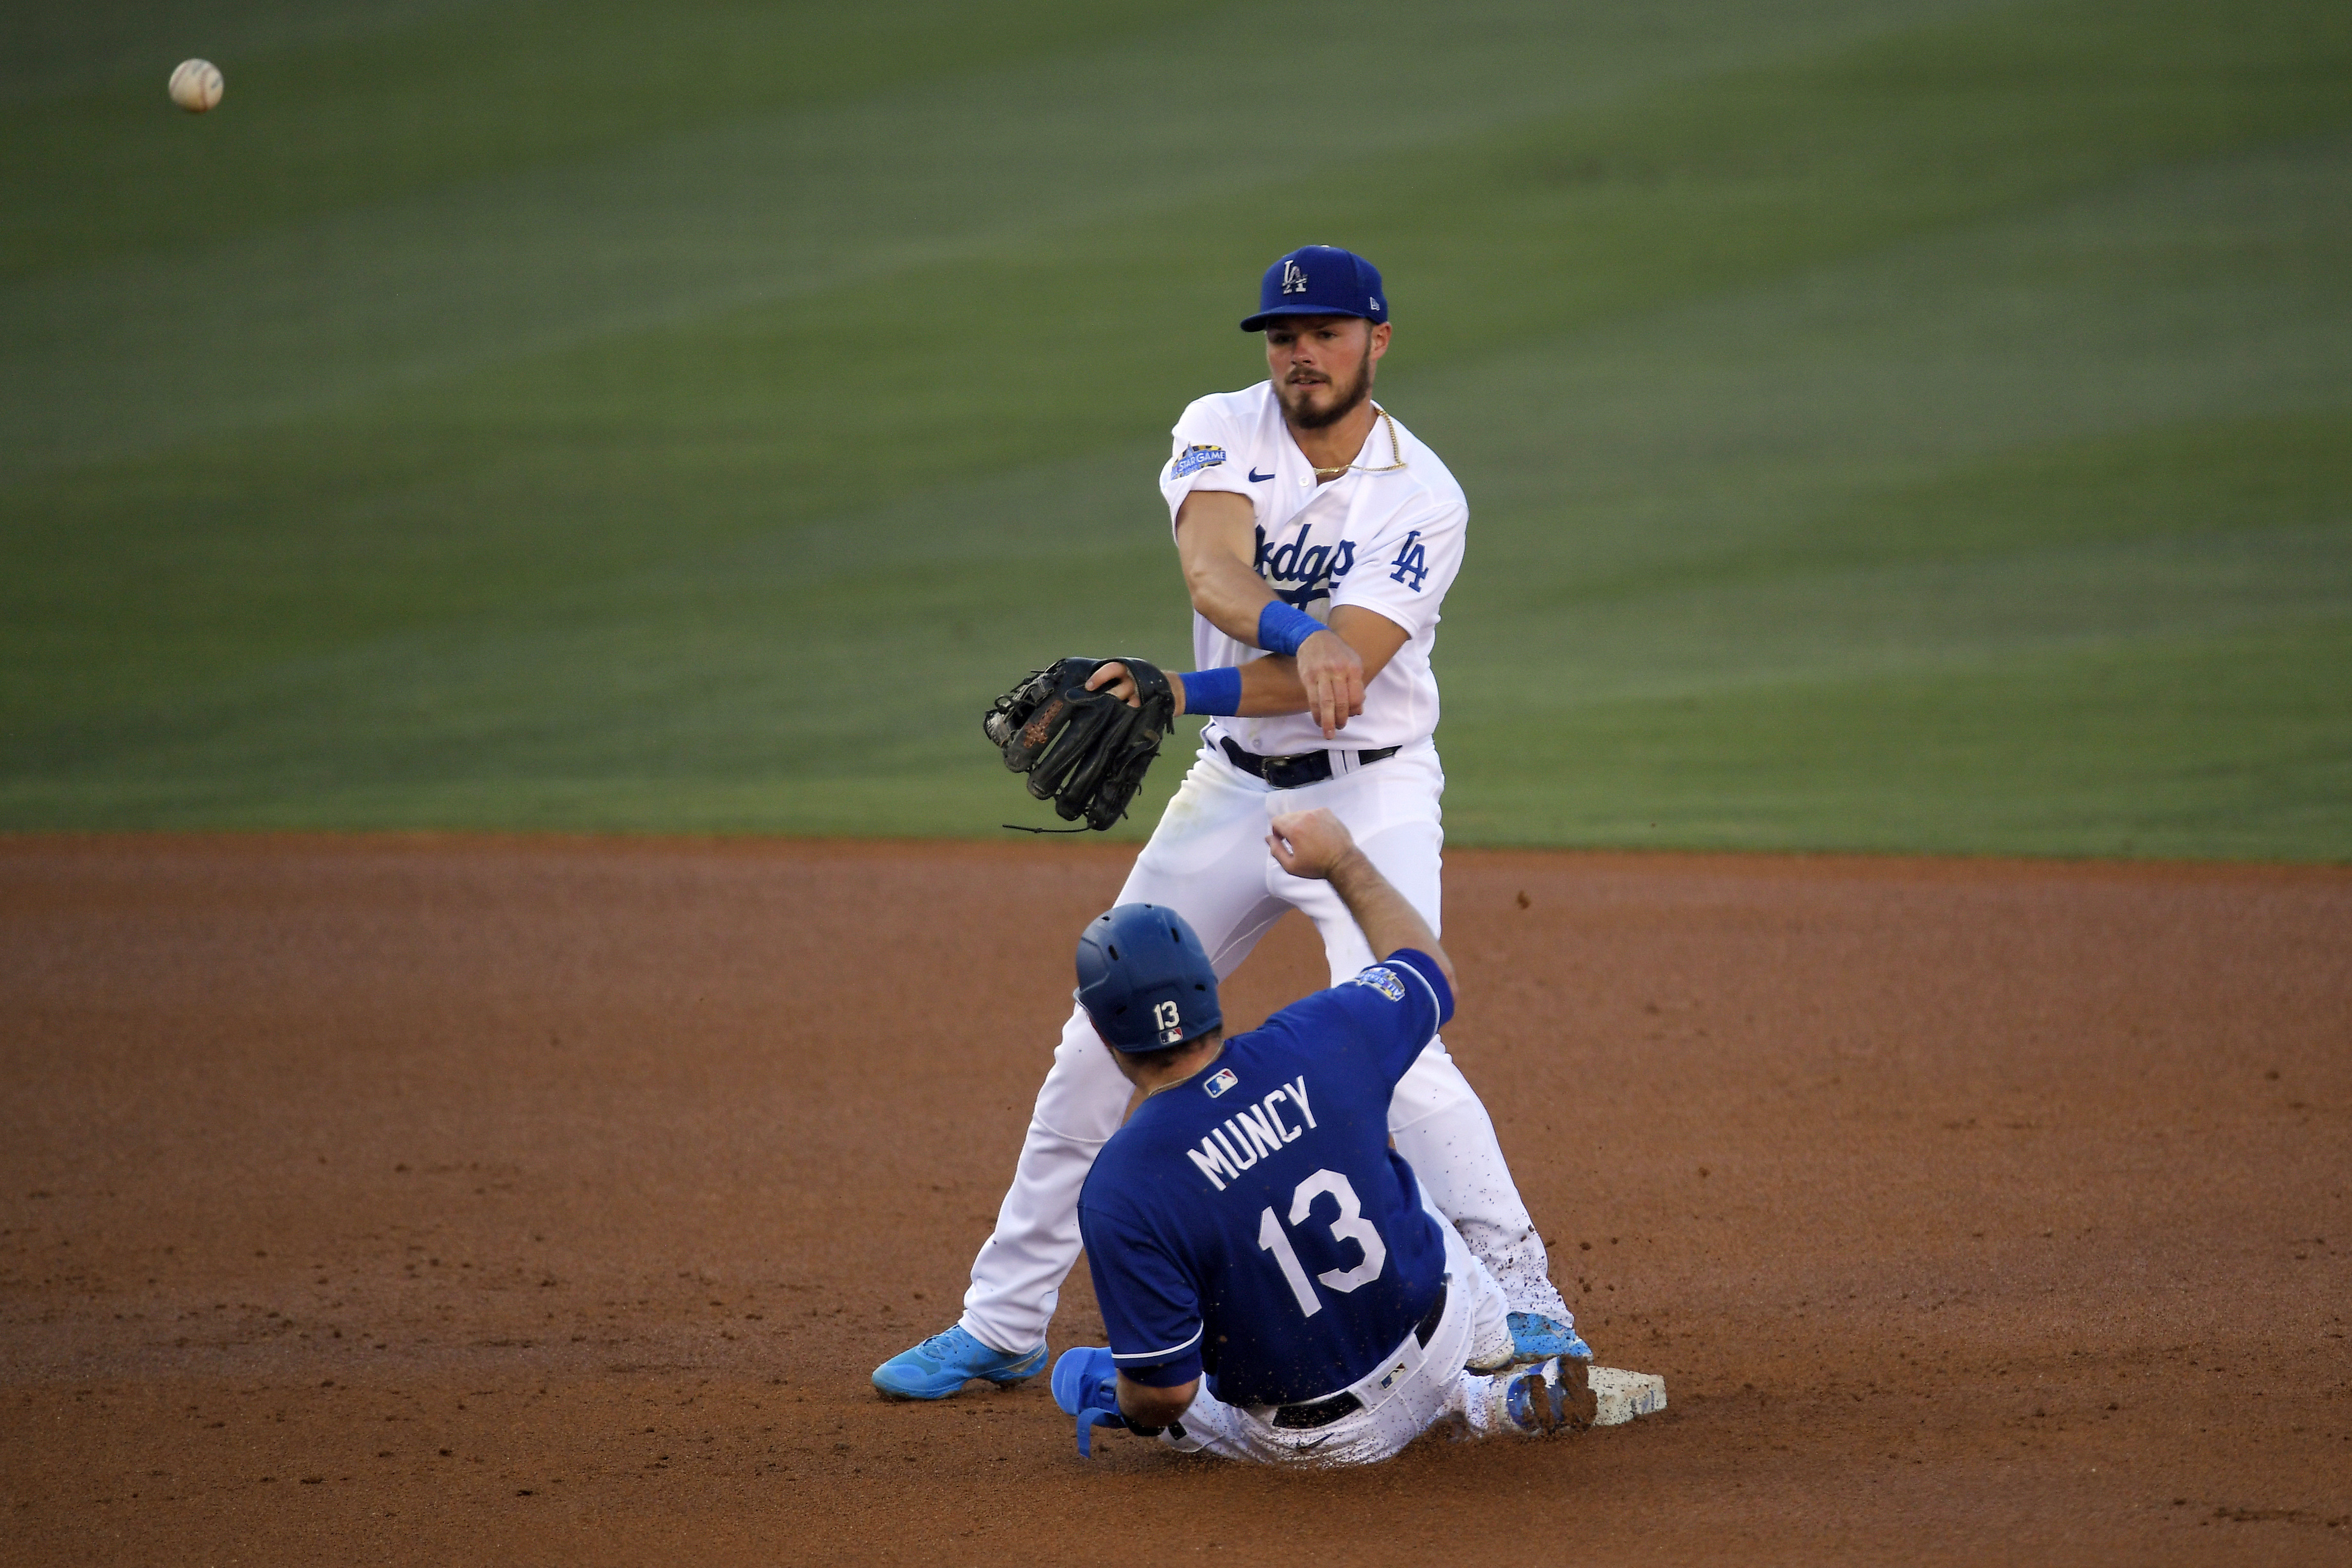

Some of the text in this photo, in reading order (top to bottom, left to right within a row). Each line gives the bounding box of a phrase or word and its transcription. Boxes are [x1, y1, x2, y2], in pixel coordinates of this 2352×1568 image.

[1282, 260, 1308, 294] LA
[1197, 451, 1225, 463] GAME
[1390, 530, 1429, 593] LA
[1154, 1001, 1180, 1030] 13
[1187, 1075, 1317, 1192] MUNCY
[1258, 1168, 1386, 1318] 13
